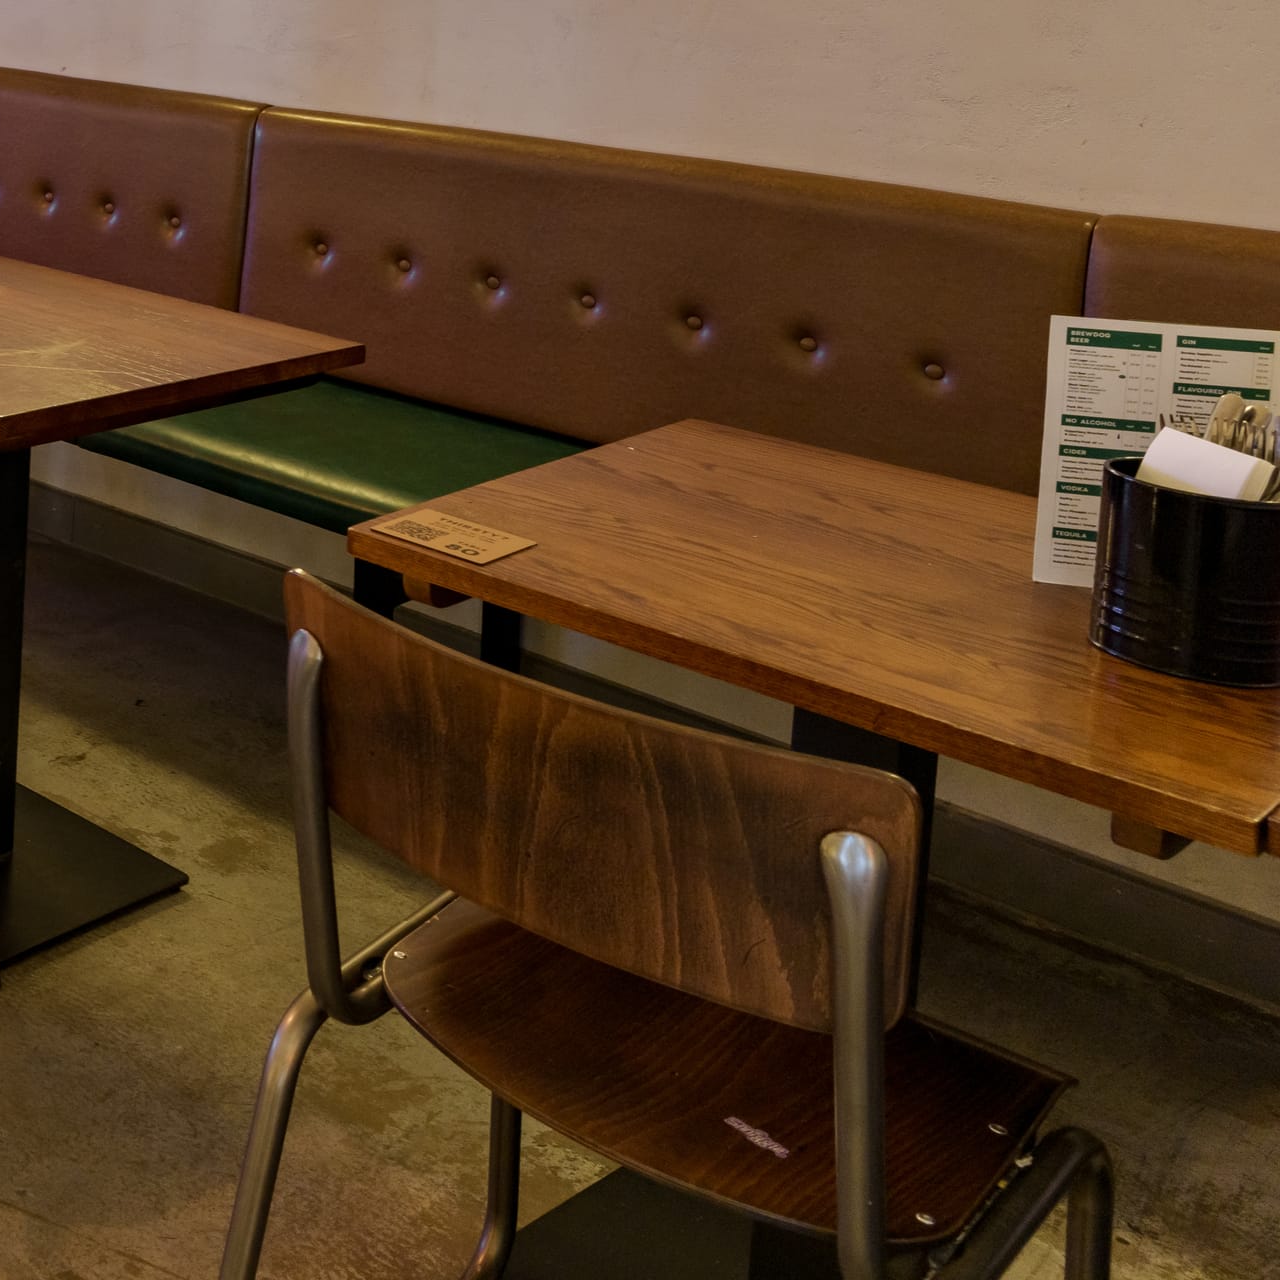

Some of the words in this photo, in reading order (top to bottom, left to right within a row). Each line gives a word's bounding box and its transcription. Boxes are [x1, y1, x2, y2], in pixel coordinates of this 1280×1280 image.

[1070, 330, 1112, 339] BREWDOG
[1177, 386, 1225, 395] FLAVOURED
[1080, 418, 1117, 428] ALCOHOL
[1063, 448, 1087, 456] CIDER
[1060, 485, 1089, 493] VODKA
[1055, 530, 1088, 538] TEQUILA
